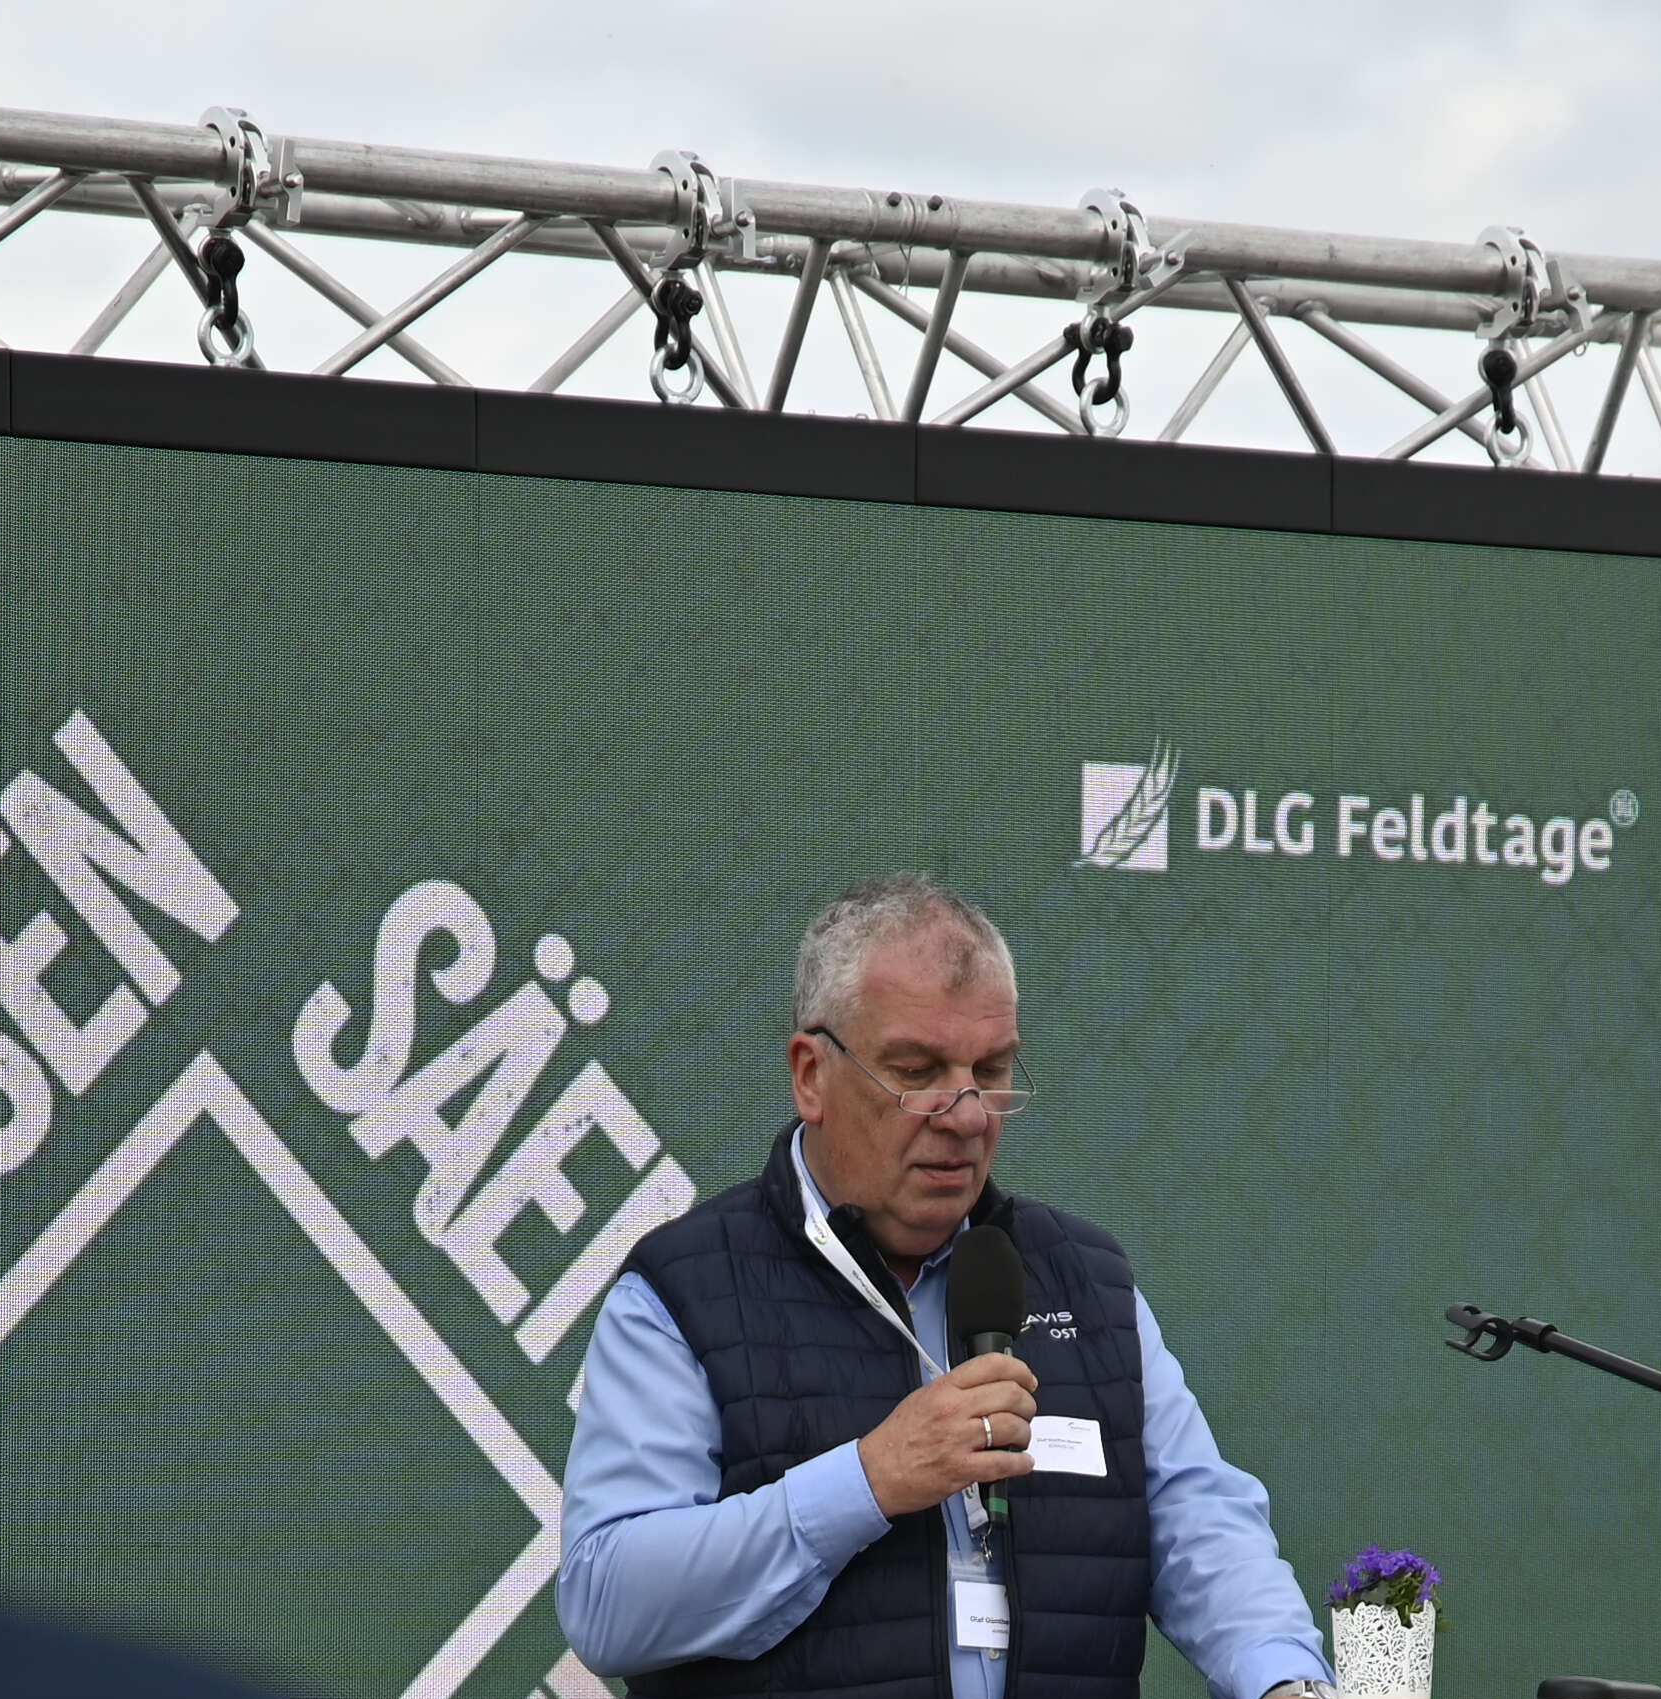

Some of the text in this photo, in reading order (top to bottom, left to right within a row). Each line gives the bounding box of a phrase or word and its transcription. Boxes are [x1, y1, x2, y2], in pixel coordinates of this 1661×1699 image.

[1196, 785, 1316, 857] DLG
[1022, 1311, 1074, 1326] AVIS
[1049, 1327, 1078, 1341] OST
